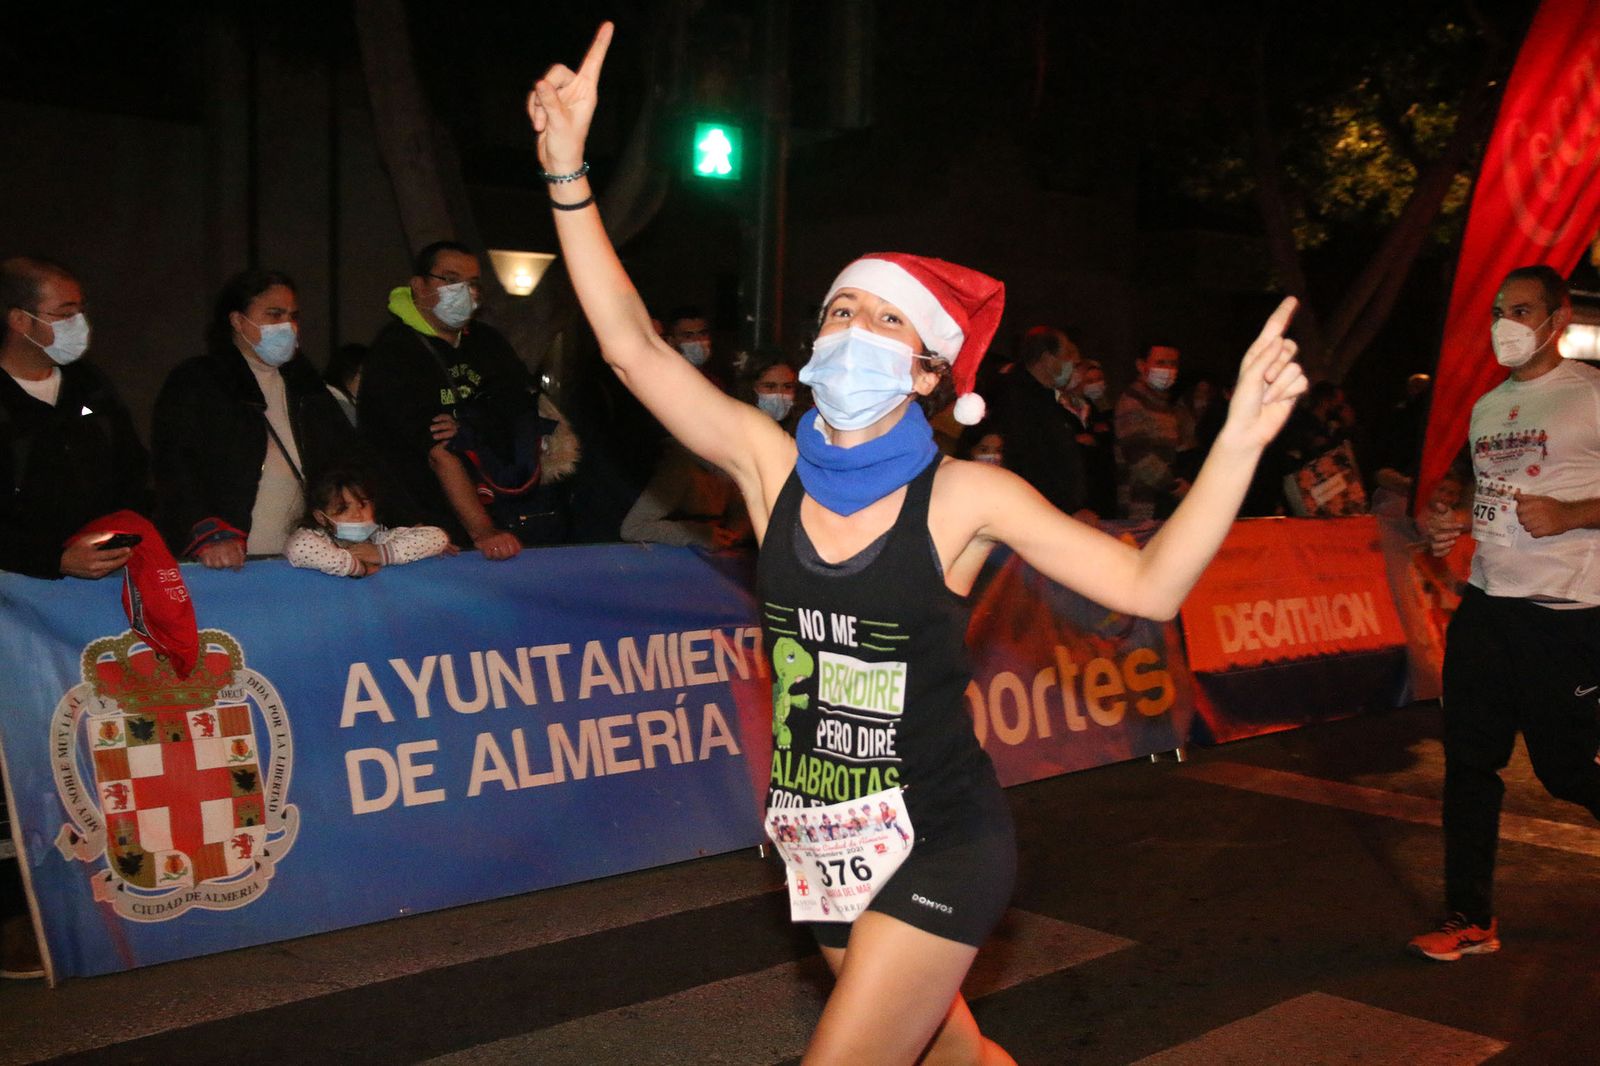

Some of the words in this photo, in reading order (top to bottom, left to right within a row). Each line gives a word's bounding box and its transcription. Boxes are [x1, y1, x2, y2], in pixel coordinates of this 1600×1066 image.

[1473, 504, 1496, 521] 476
[798, 607, 826, 642] NO
[831, 612, 858, 647] ME
[1212, 591, 1382, 654] DECATHLON
[822, 661, 903, 712] RENDIRÉ
[60, 696, 81, 728] LEAL
[267, 703, 283, 728] POR
[58, 730, 70, 759] MUY
[276, 733, 286, 749] LA
[816, 718, 852, 755] PERO
[857, 722, 897, 757] DIRÉ
[345, 739, 446, 816] DE
[467, 692, 742, 798] ALMERÍA
[61, 763, 81, 804] NOBLE
[268, 755, 286, 813] LIBERTAD
[79, 807, 100, 833] MUY
[815, 855, 873, 888] 376
[132, 896, 183, 915] CIUDAD
[185, 891, 202, 902] DE
[911, 893, 953, 914] DOMYOS
